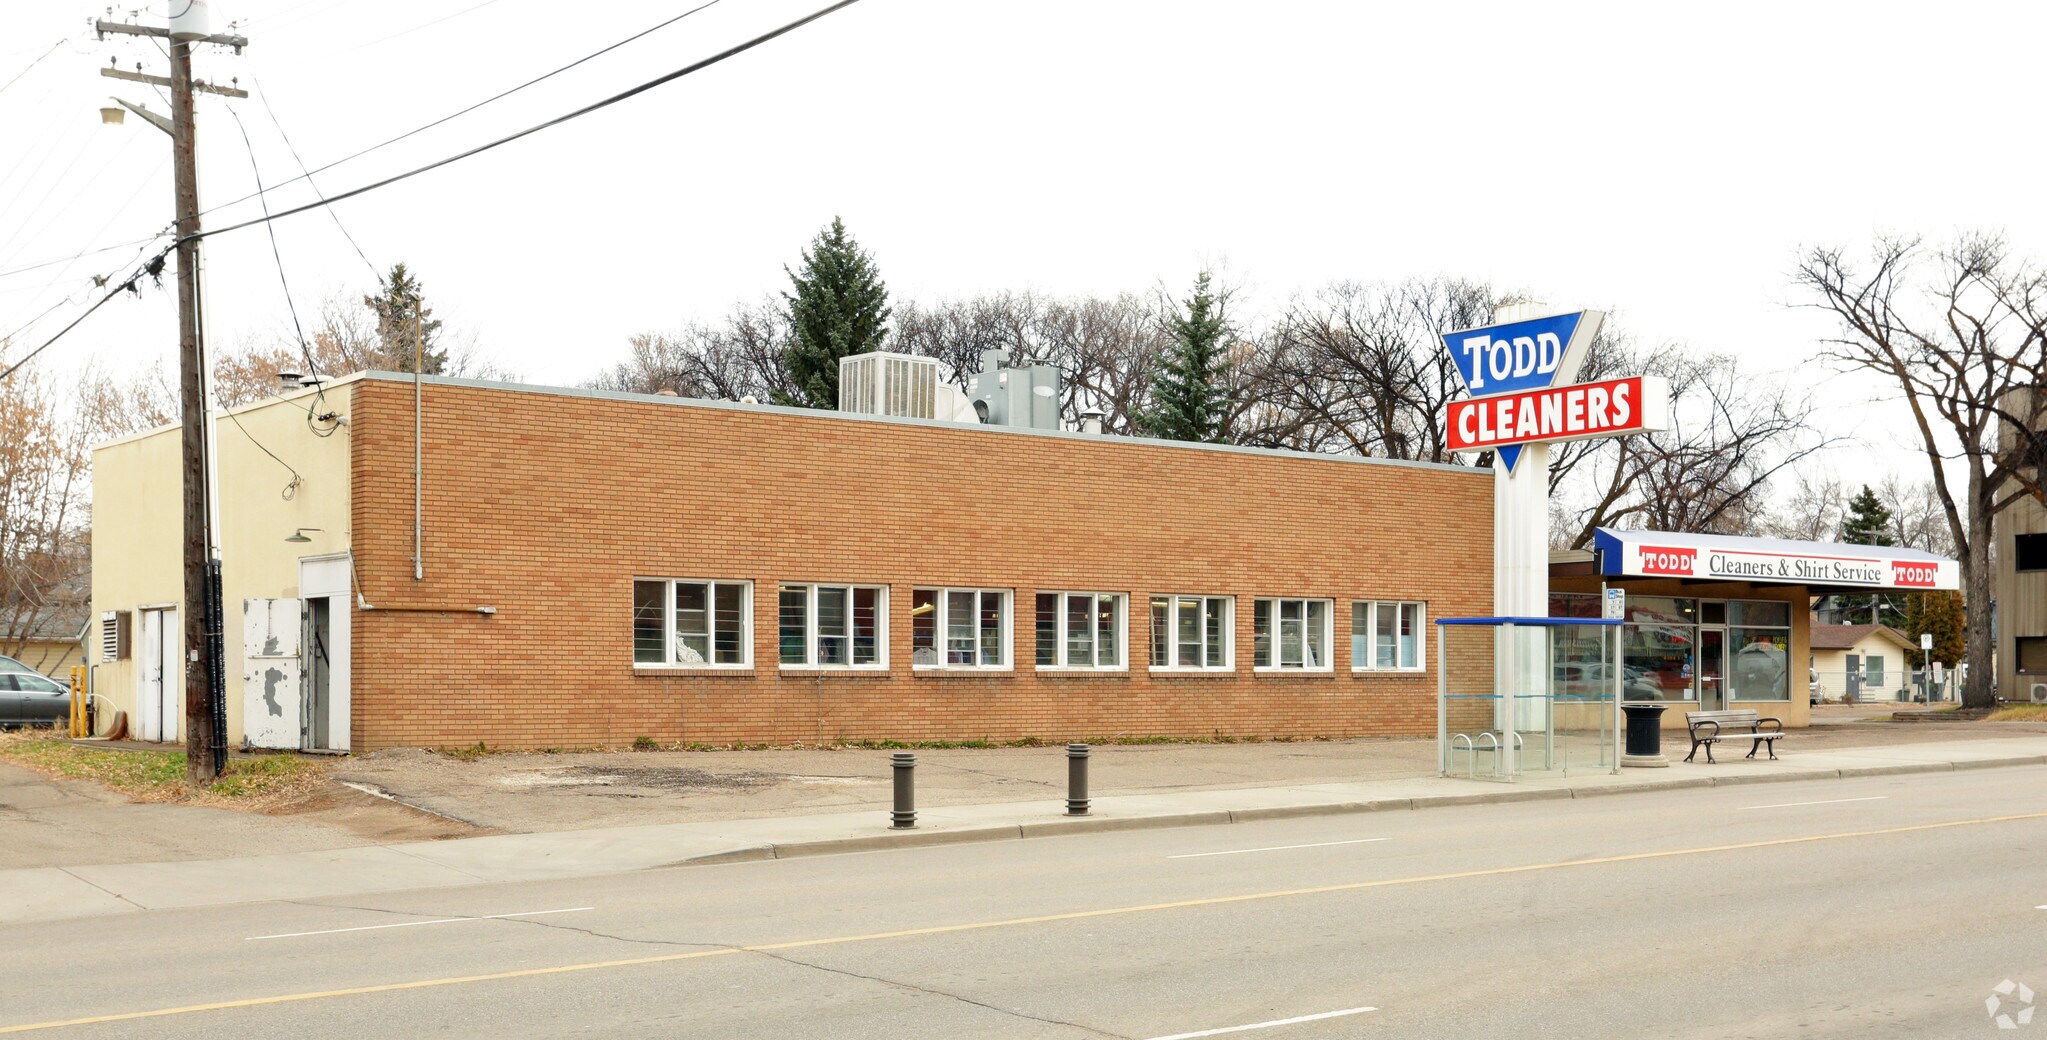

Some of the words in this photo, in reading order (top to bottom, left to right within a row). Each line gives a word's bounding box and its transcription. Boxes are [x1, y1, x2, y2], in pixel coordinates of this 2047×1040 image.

[1463, 332, 1561, 389] TODD
[1458, 383, 1631, 445] CLEANERS
[1645, 552, 1691, 571] TODD
[1709, 554, 1773, 576] Cleaners
[1778, 558, 1790, 577] &
[1795, 559, 1829, 579] Shirt
[1833, 561, 1882, 581] Service
[1896, 566, 1934, 583] TODD
